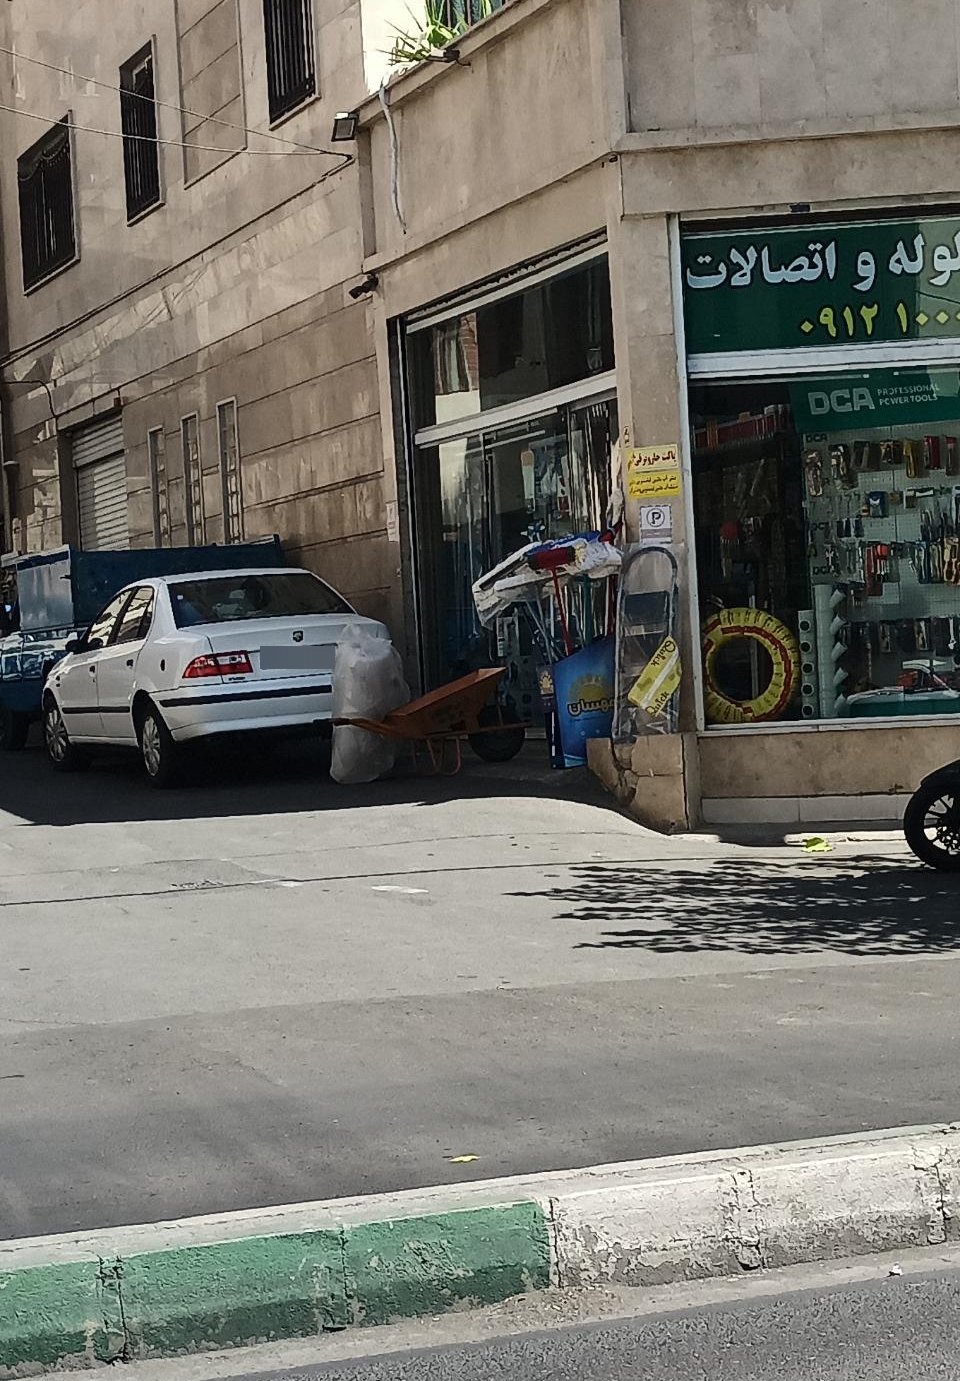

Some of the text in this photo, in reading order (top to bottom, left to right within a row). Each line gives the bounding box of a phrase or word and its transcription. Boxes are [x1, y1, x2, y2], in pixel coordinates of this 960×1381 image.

[686, 240, 837, 289] اتصالات
[852, 250, 876, 292] و
[800, 303, 879, 338] ۰۹۱۲
[807, 386, 876, 415] DCA
[879, 392, 938, 406] POWER TOOLS
